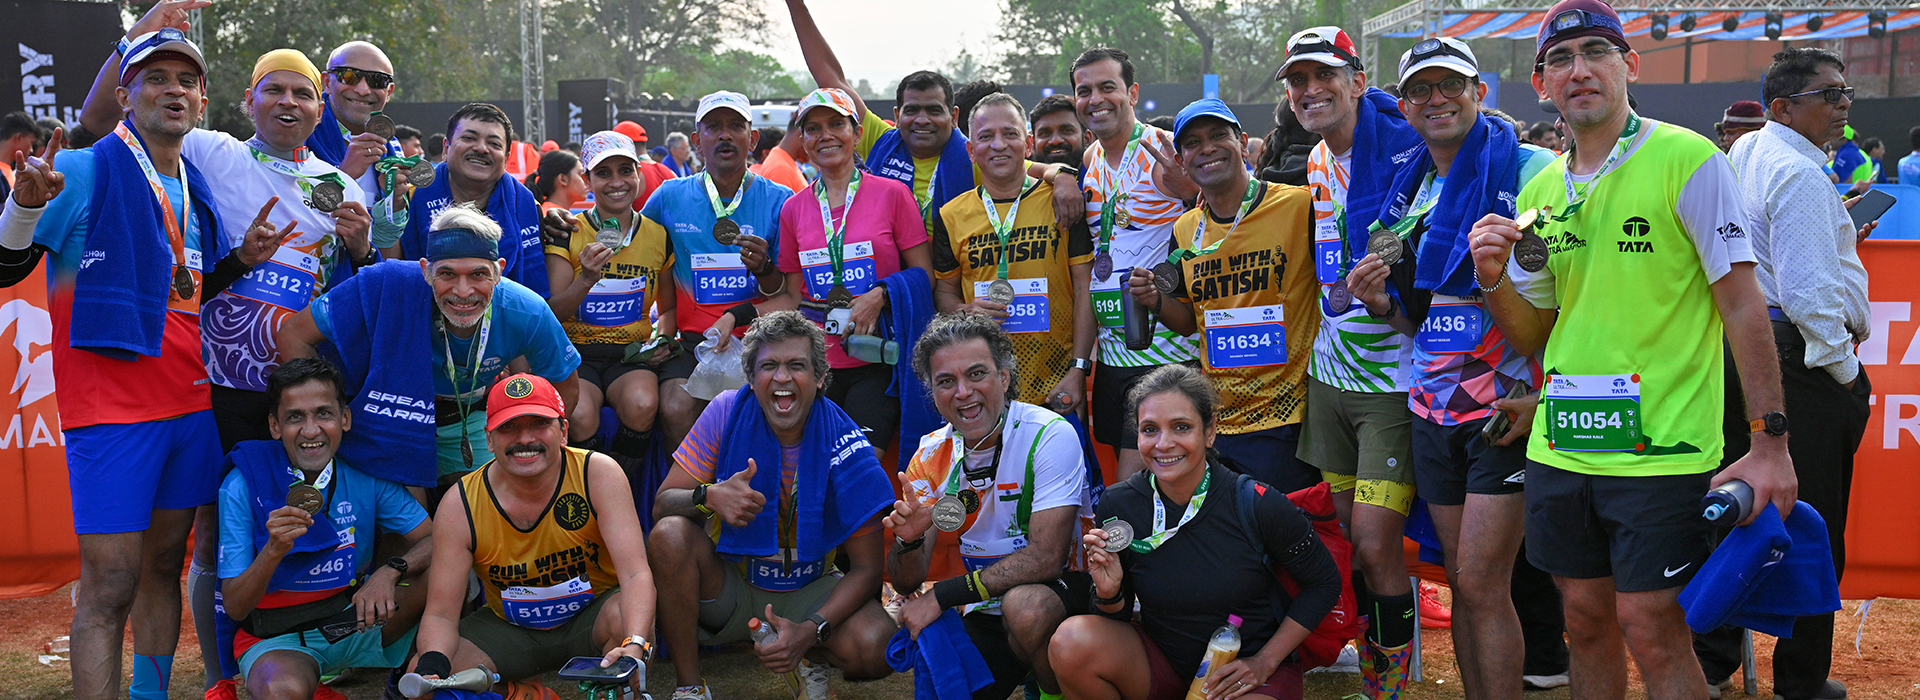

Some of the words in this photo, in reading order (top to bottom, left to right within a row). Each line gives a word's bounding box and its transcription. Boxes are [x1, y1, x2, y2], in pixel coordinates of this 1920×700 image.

[968, 232, 999, 250] RUN
[1008, 225, 1049, 243] WITH
[968, 240, 1047, 269] SATISH
[1617, 241, 1655, 253] TATA
[616, 263, 649, 276] WITH
[1193, 258, 1222, 280] RUN
[1228, 249, 1272, 272] WITH
[700, 275, 748, 289] 51429
[815, 267, 865, 285] 5280
[1191, 267, 1270, 303] SATISH
[586, 299, 635, 313] 52277
[1096, 298, 1121, 312] 5191
[1217, 332, 1272, 351] 51634
[479, 364, 502, 373] TATA
[1557, 411, 1623, 429] 51054
[0, 412, 65, 450] MA
[1200, 478, 1208, 490] KMS
[335, 514, 357, 524] TATA
[1109, 534, 1124, 543] TATA
[488, 563, 528, 580] RUN
[534, 546, 585, 574] WITH
[568, 586, 583, 594] TATA
[518, 601, 581, 618] 51736
